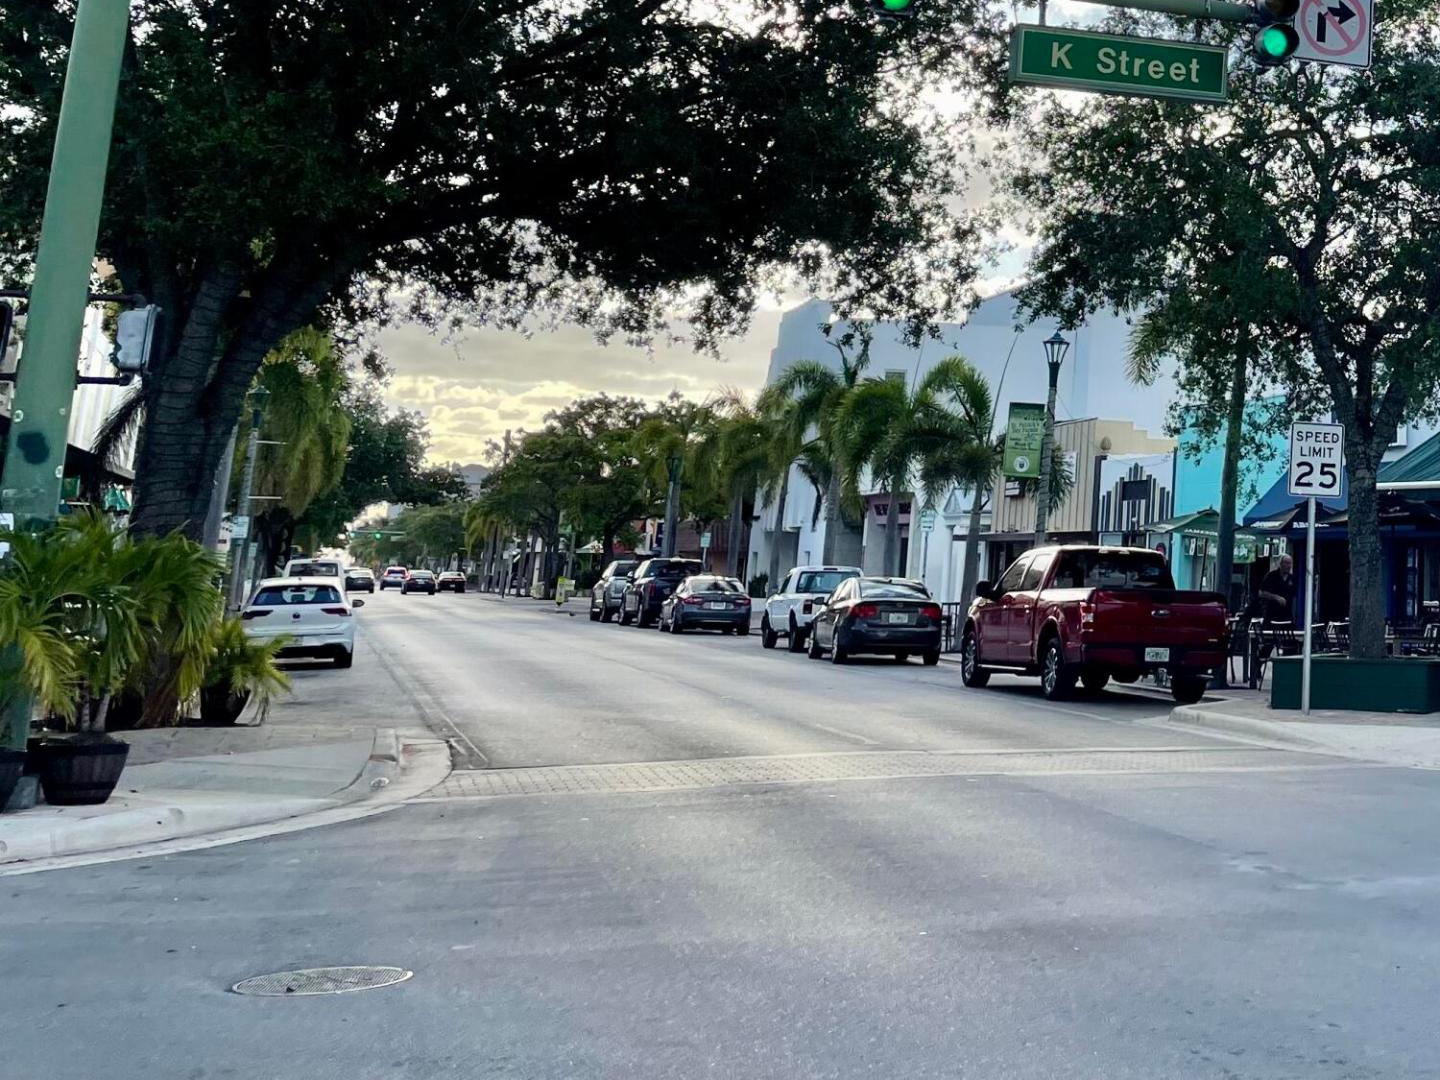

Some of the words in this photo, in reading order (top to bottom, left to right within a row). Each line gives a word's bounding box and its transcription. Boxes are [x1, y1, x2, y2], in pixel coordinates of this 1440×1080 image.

[1050, 41, 1073, 70] K
[1096, 47, 1200, 84] Street
[1296, 431, 1340, 444] SPEED
[1300, 446, 1334, 458] LIMIT
[1294, 461, 1337, 489] 25
